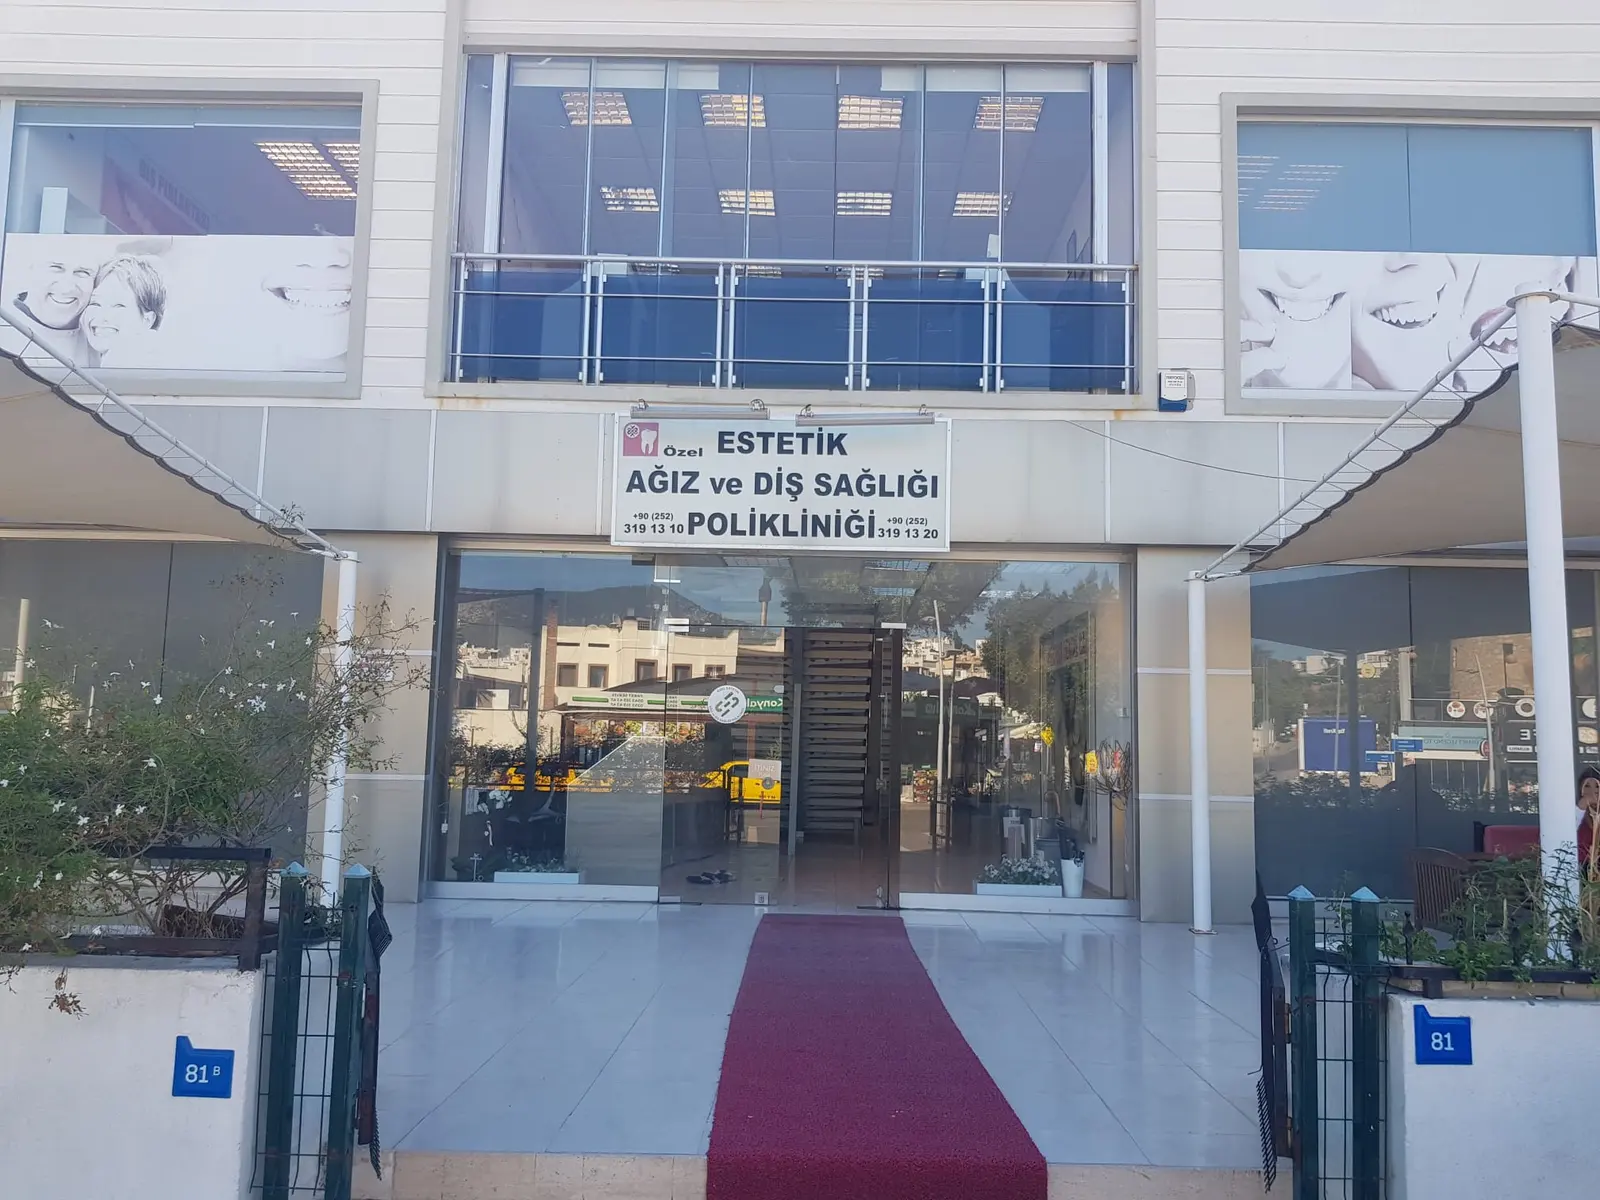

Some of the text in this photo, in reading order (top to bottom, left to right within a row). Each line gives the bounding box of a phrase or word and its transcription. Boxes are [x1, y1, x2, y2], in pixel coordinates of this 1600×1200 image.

[663, 427, 848, 457] Özel ESTETİK
[625, 464, 938, 502] AĞIZ ve DİŞ SAĞLIĞI
[651, 512, 674, 521] (252)
[688, 507, 875, 539] POLİKLİNİĞİ
[887, 517, 928, 526] +90 (252)
[624, 524, 684, 534] 319 13 10
[878, 528, 938, 539] 319 13 20
[1431, 1031, 1455, 1051] 81
[185, 1063, 221, 1084] 81 B
